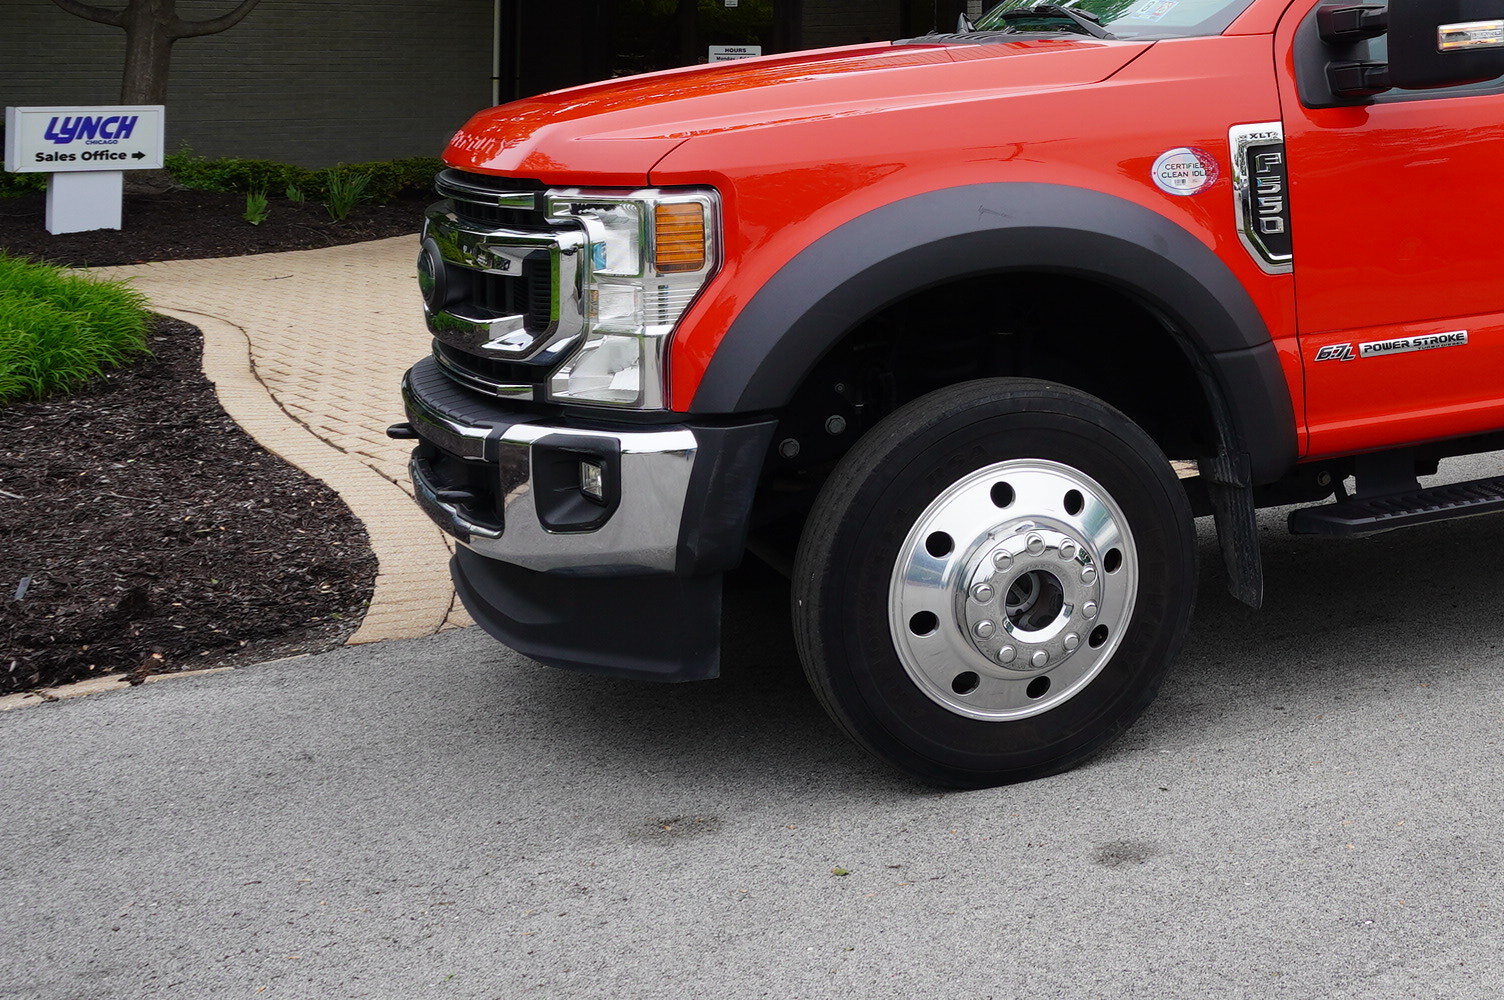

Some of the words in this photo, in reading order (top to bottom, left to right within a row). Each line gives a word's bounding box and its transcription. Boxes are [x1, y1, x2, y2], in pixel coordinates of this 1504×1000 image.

[44, 116, 139, 144] LYNCH
[35, 151, 76, 162] Sales
[81, 150, 127, 161] Office
[1161, 171, 1189, 179] CLEAN
[1165, 162, 1206, 171] CERTIFIED
[1255, 152, 1285, 235] F550
[1315, 343, 1356, 362] 6.7L
[1363, 339, 1410, 354] POWER
[1413, 332, 1465, 347] STROKE
